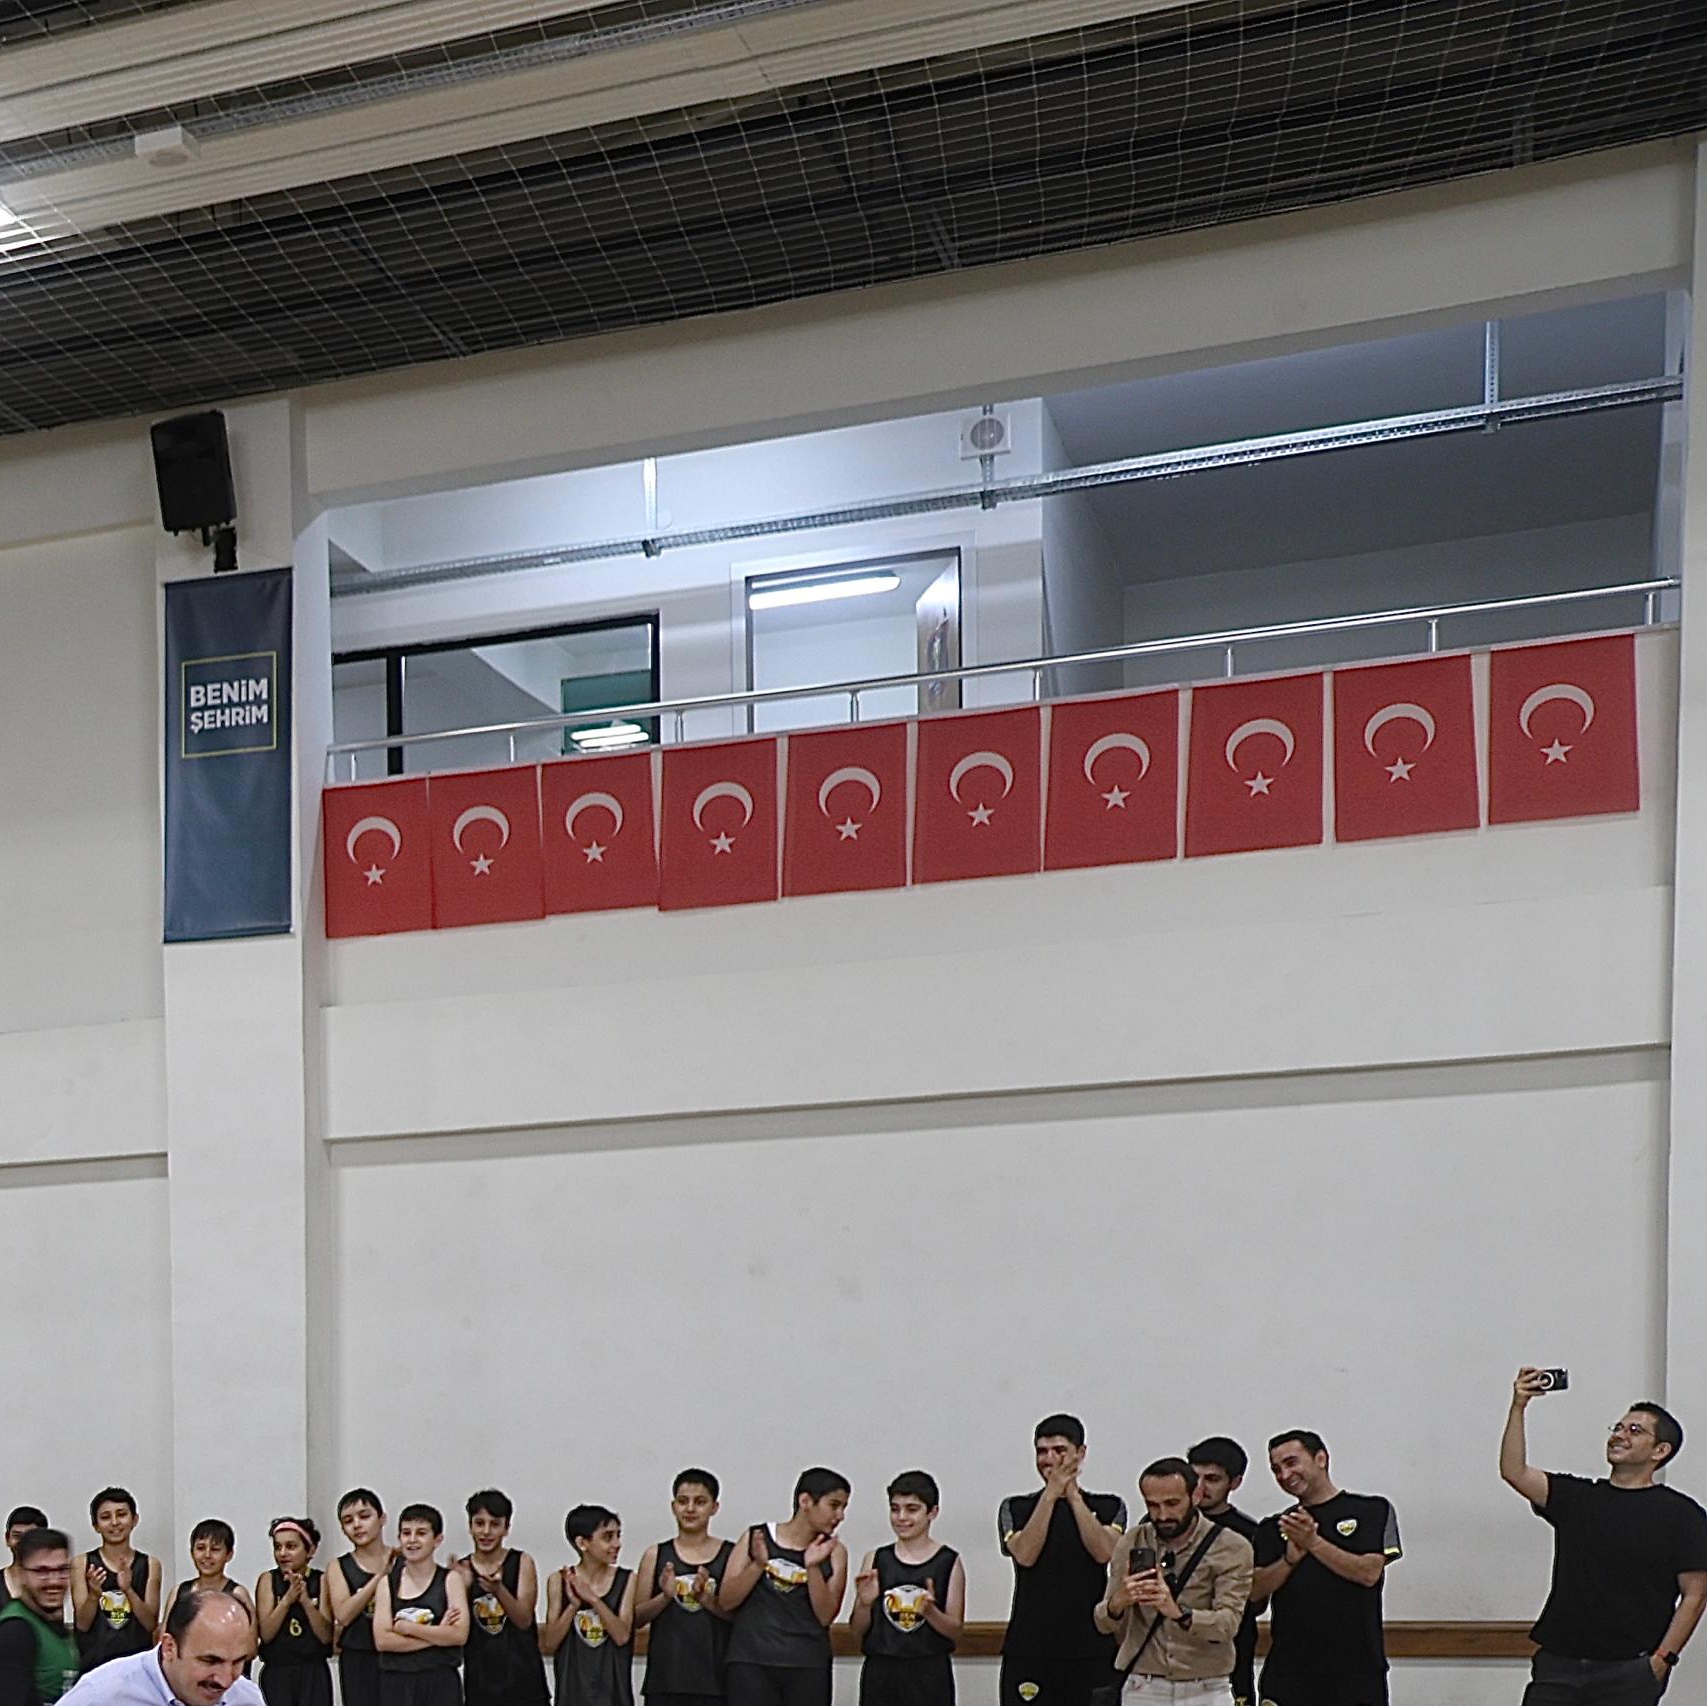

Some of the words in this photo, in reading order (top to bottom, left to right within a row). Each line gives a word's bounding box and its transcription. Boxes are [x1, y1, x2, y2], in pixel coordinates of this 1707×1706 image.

[190, 678, 268, 707] BENİM
[190, 704, 268, 734] ŞEHRİM
[289, 1618, 303, 1636] 6
